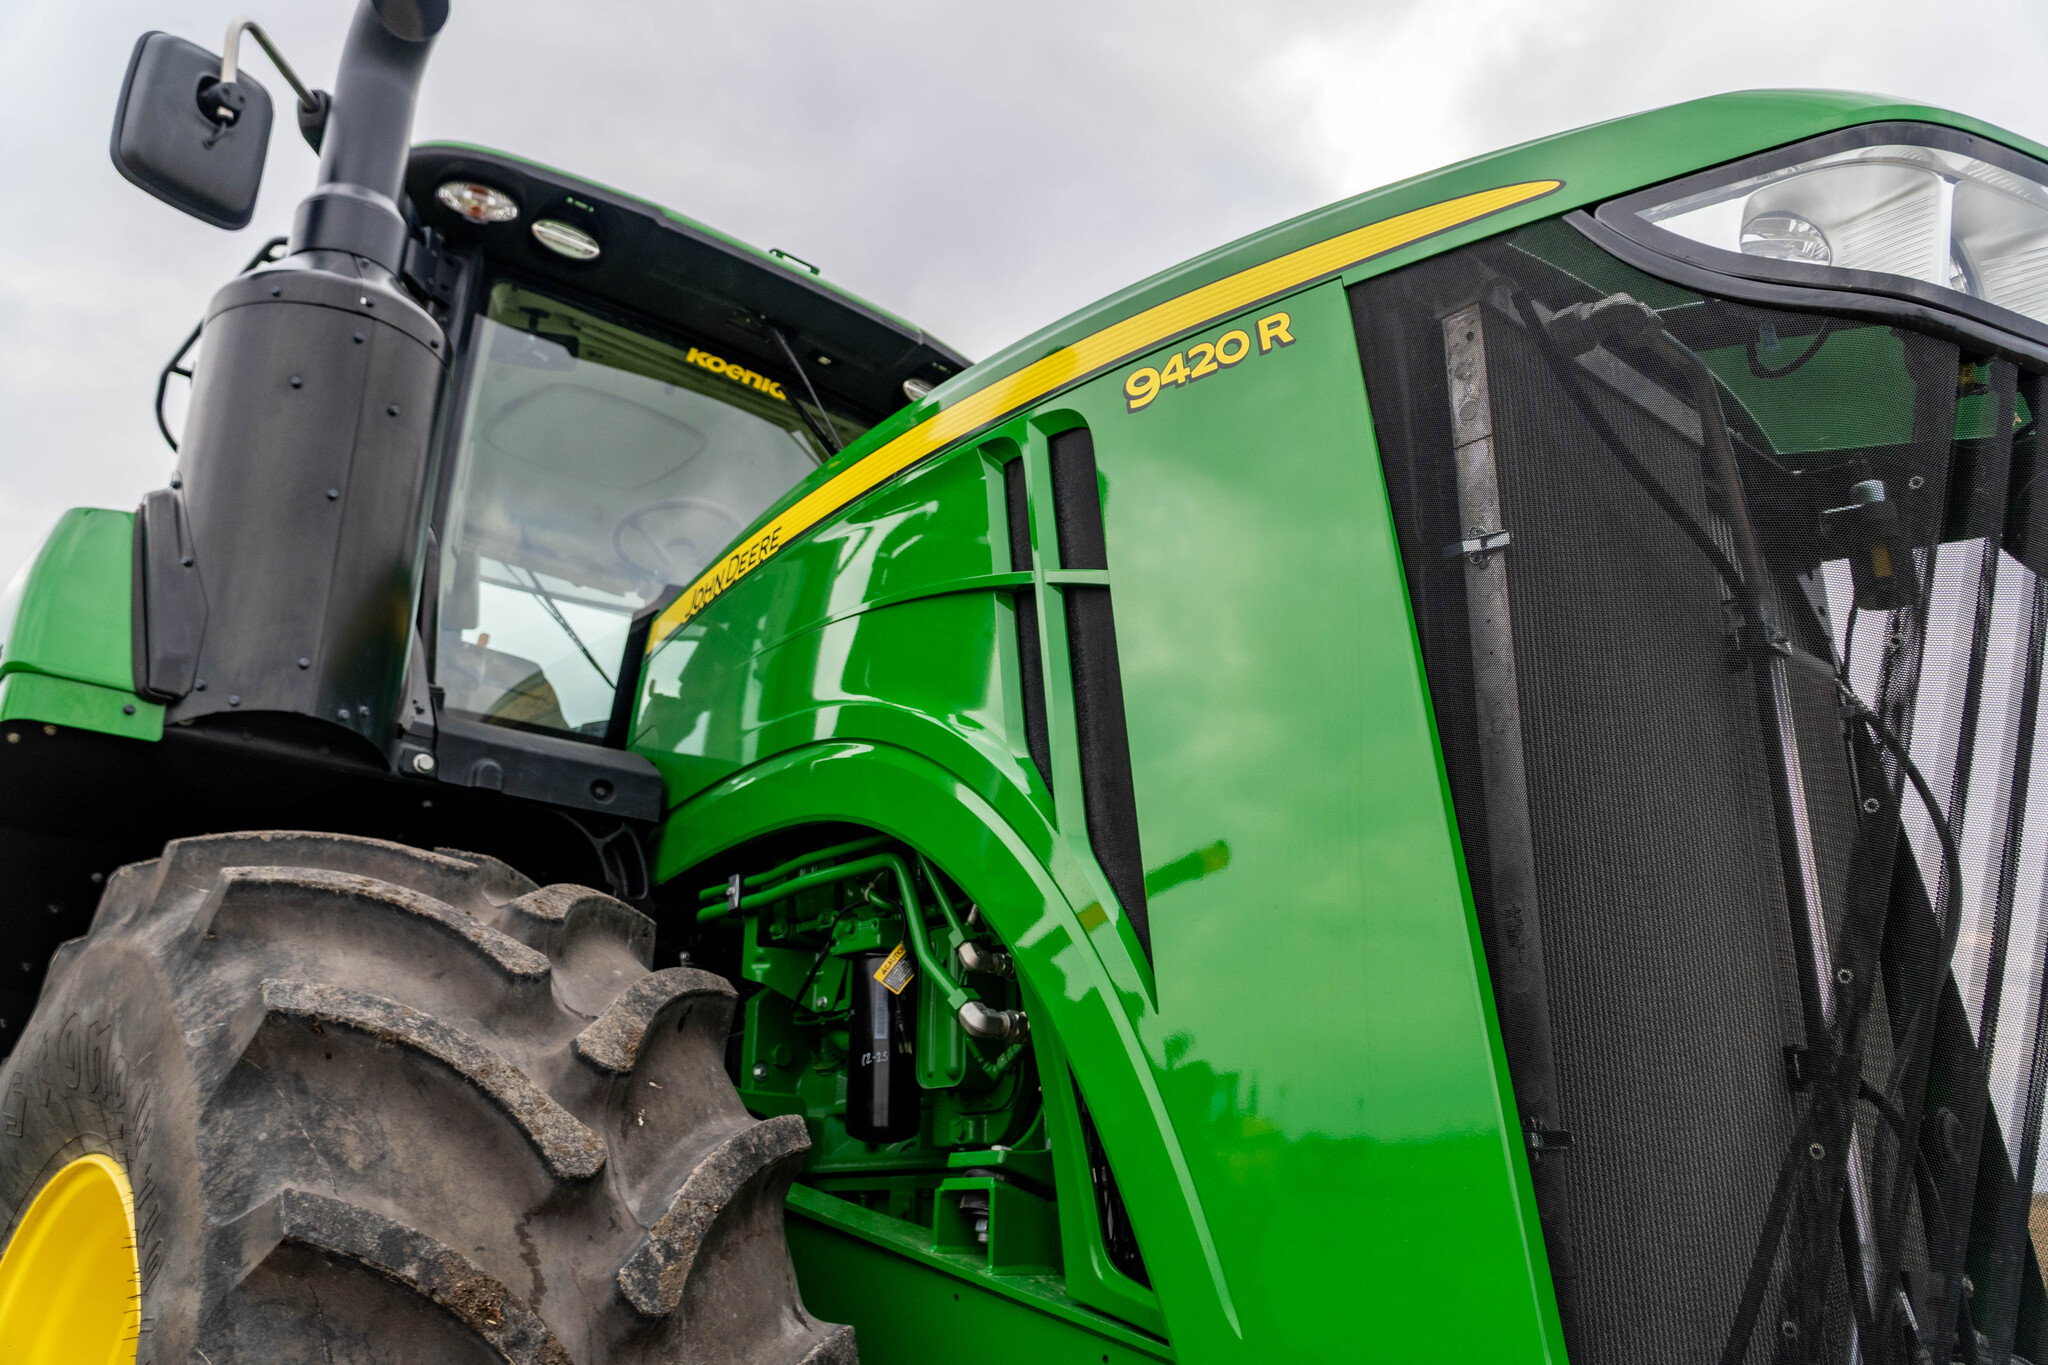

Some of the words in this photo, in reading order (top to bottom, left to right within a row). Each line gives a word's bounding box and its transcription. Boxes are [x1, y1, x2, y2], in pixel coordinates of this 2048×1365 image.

[1123, 329, 1251, 414] 9420
[1255, 311, 1297, 356] R
[683, 568, 727, 622] JOHN
[726, 526, 783, 584] DEERE
